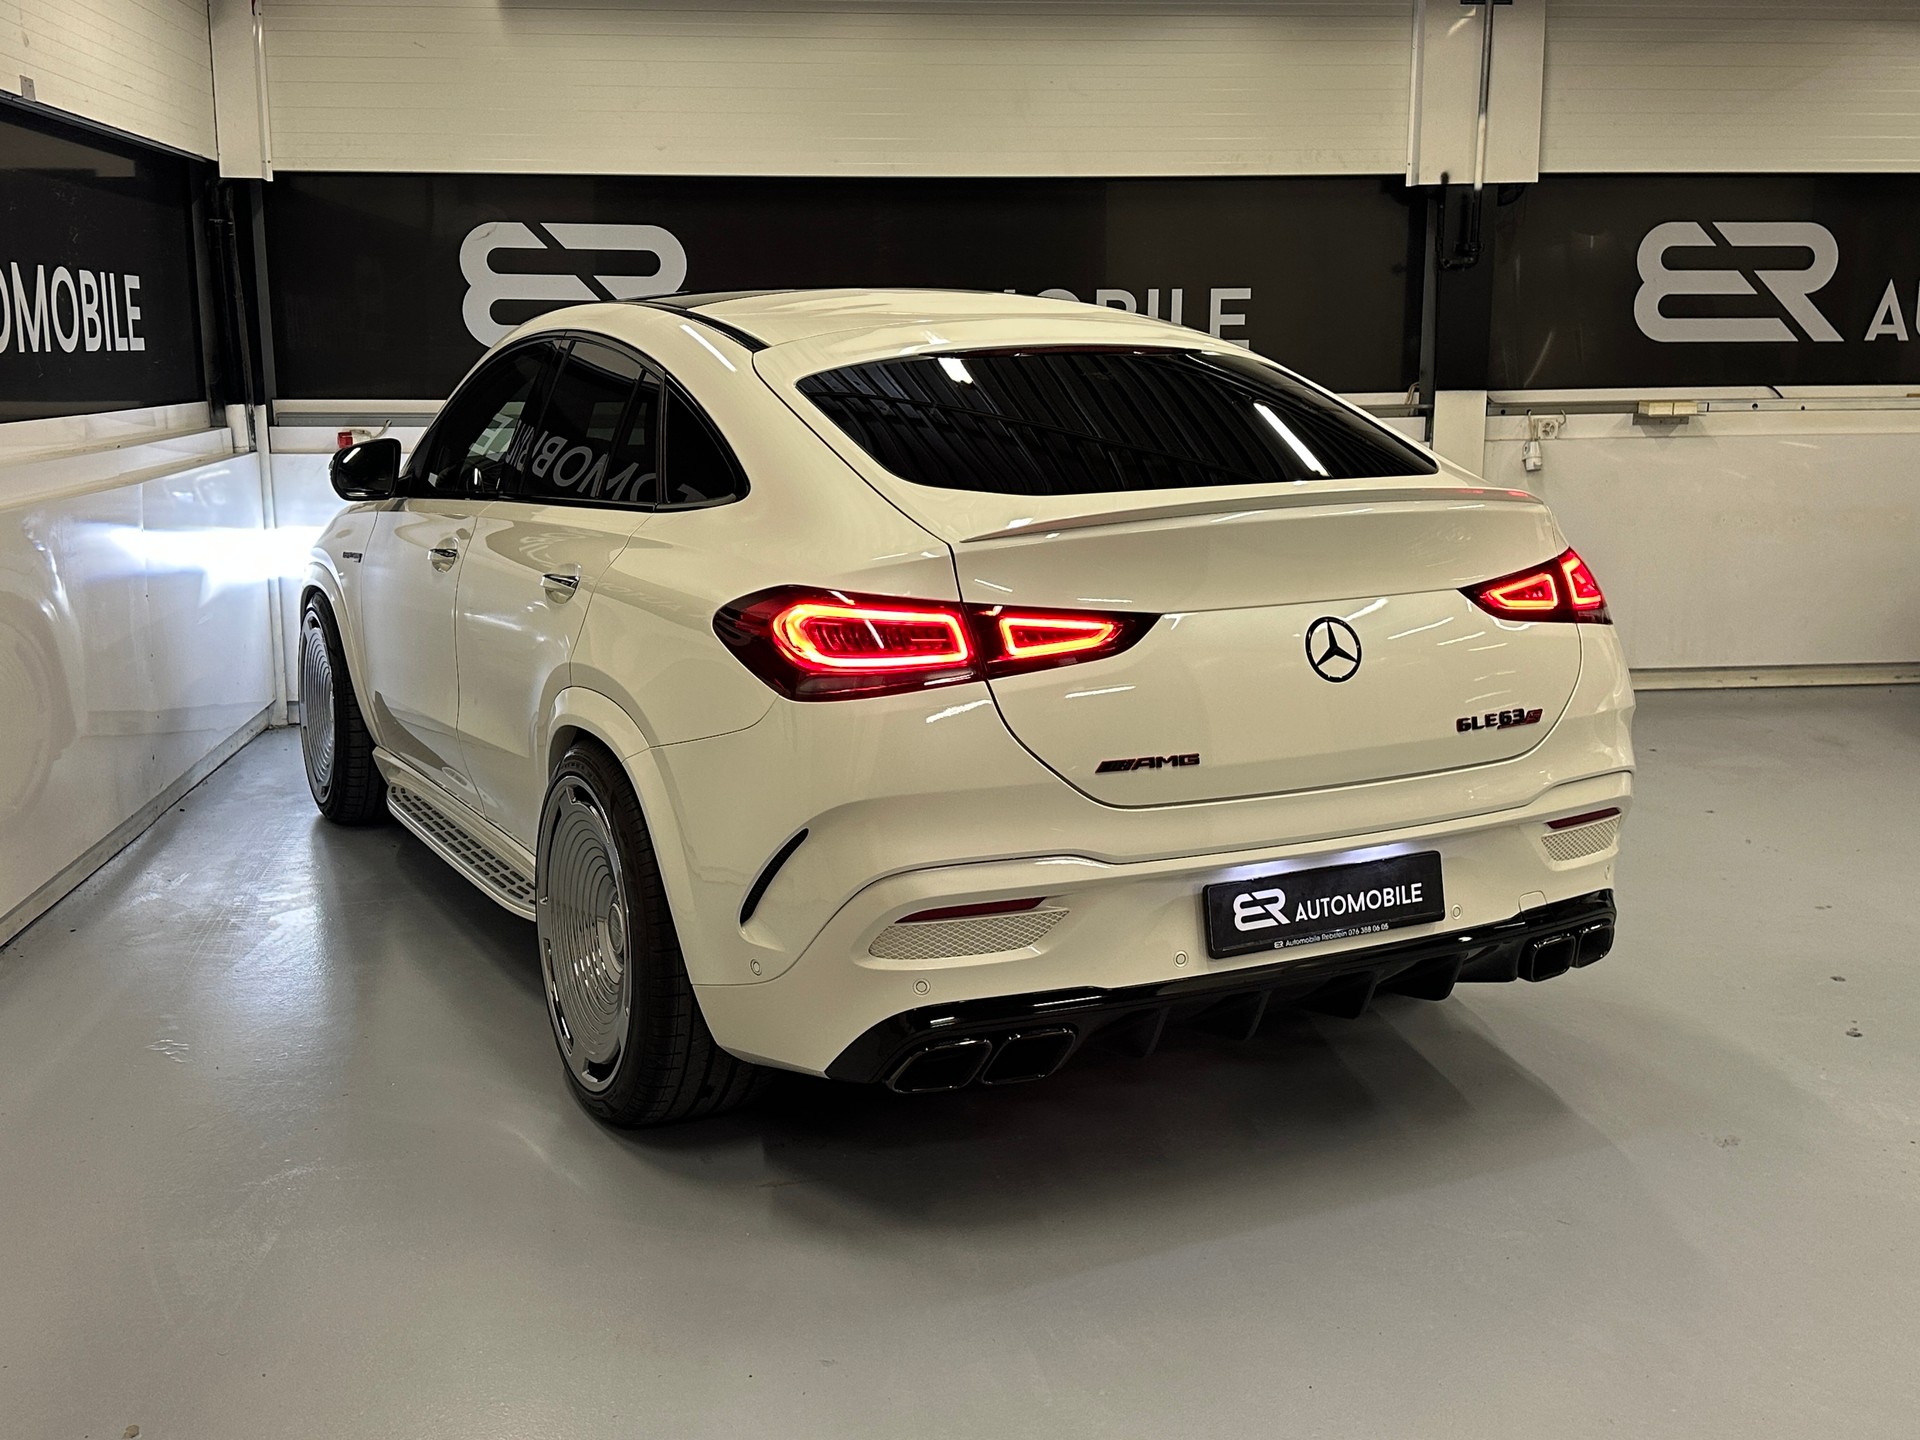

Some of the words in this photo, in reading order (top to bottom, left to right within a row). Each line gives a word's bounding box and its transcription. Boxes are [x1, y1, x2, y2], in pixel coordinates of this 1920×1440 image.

[1863, 278, 1920, 342] A
[1295, 882, 1423, 923] AUTOMOBILE
[1285, 935, 1321, 947] Automobile
[1348, 928, 1360, 937] 076
[1360, 925, 1372, 934] 388
